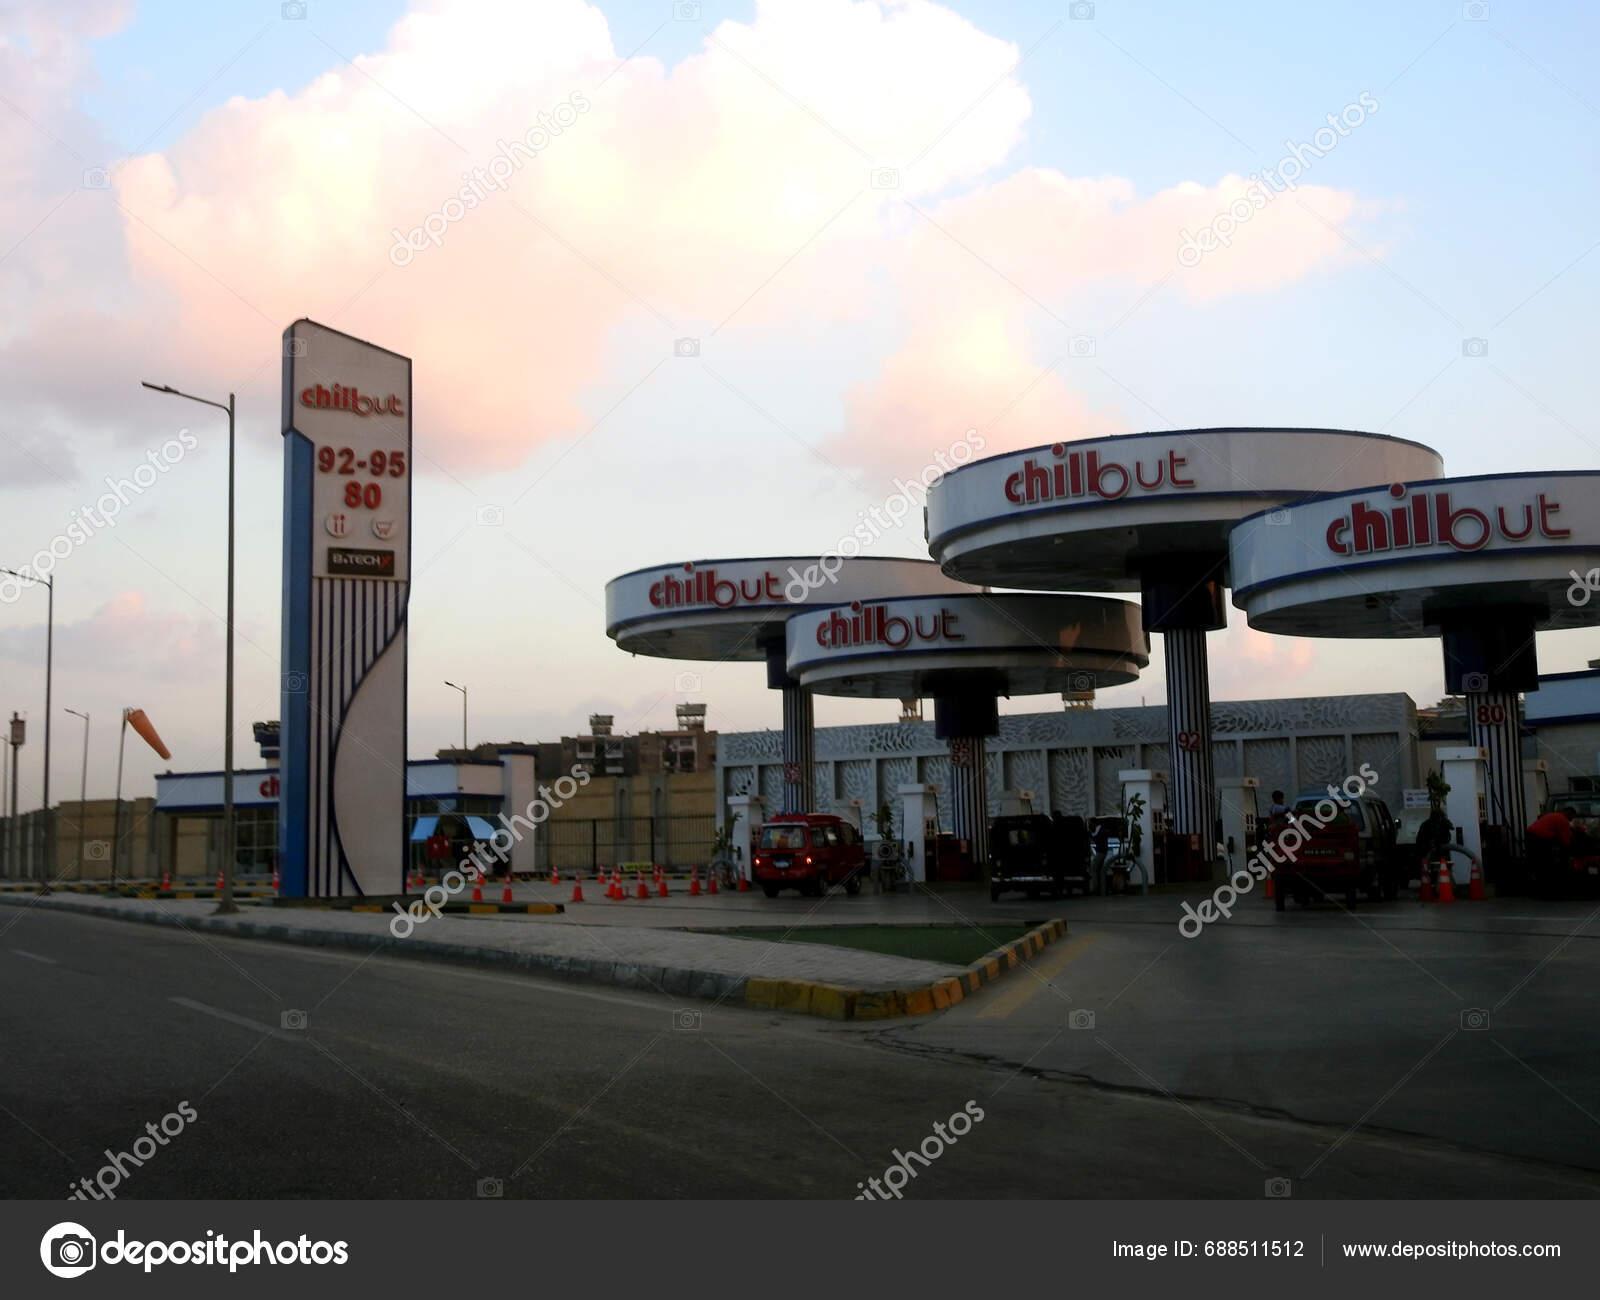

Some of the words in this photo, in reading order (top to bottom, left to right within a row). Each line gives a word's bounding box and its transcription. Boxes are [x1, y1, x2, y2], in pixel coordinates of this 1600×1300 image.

[318, 446, 405, 478] 92-95
[344, 481, 382, 510] 80
[1476, 704, 1505, 725] 80
[1178, 731, 1201, 750] 92
